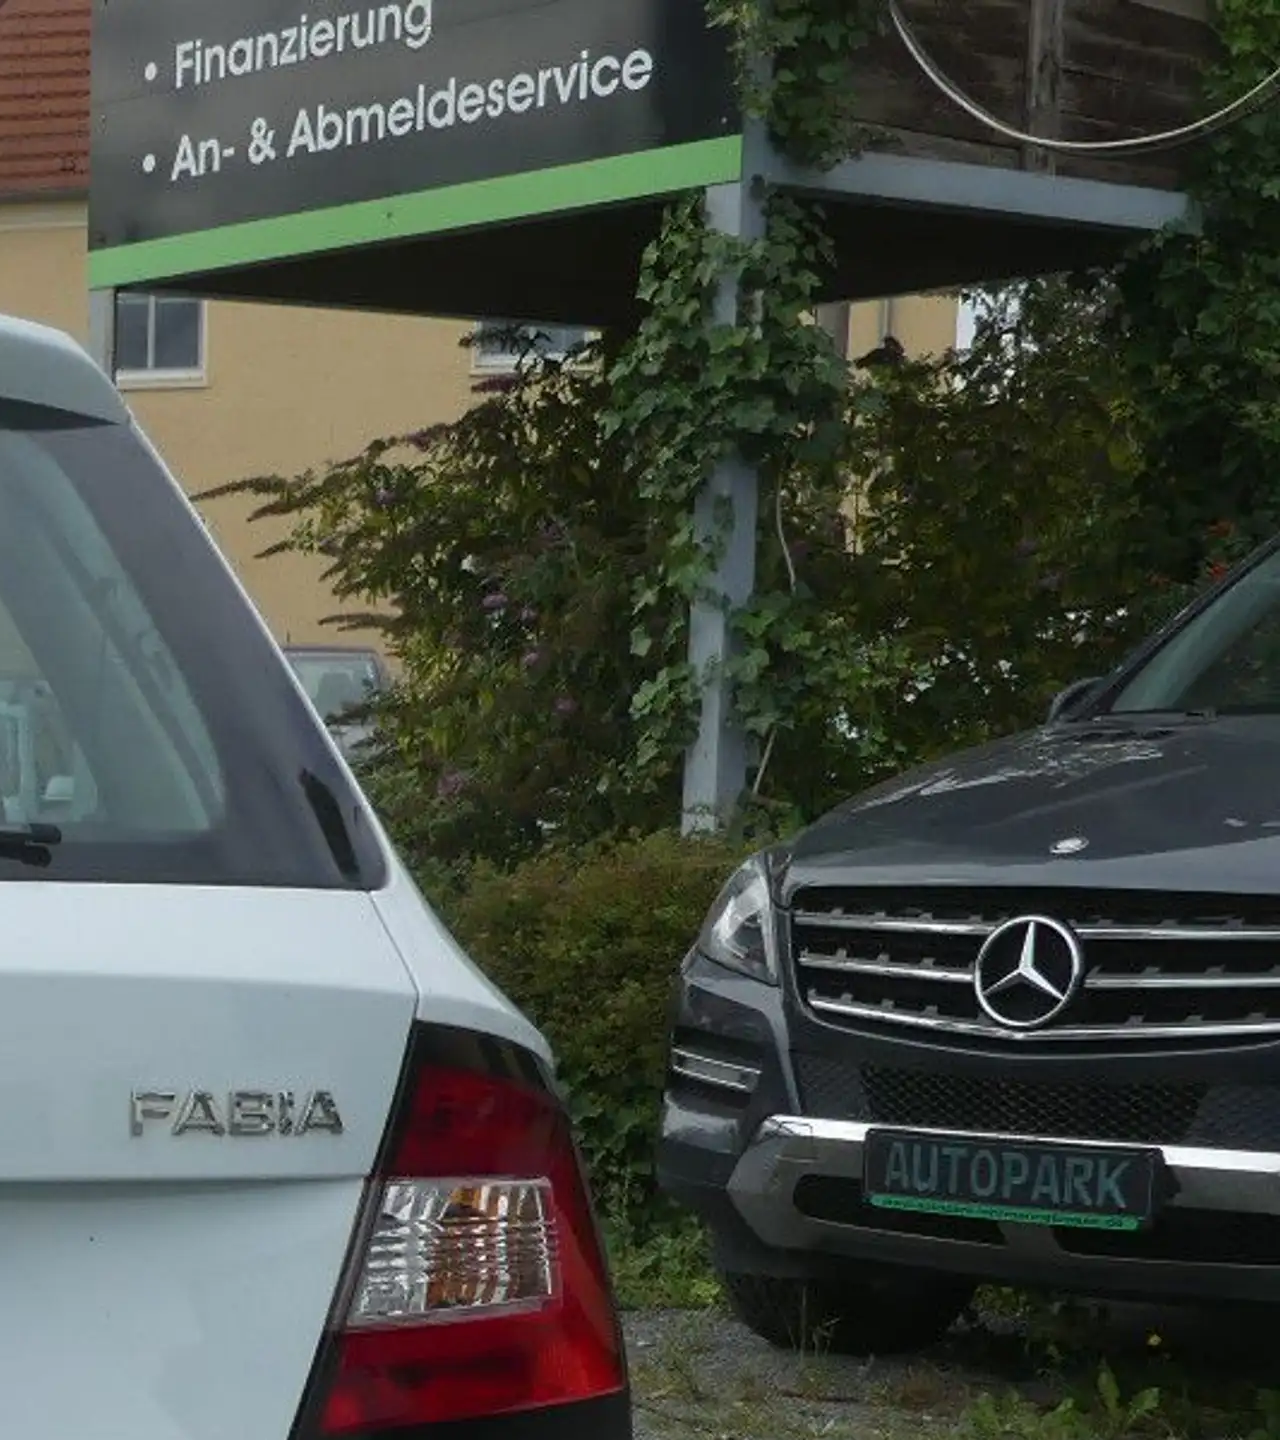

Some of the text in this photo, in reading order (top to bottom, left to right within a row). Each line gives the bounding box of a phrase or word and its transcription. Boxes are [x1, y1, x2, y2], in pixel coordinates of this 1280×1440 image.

[174, 0, 433, 88] Finanzierung
[171, 48, 654, 181] An- & Abmeldeservice
[129, 1090, 344, 1137] FABIA
[884, 1141, 1131, 1209] AUTOPARK
